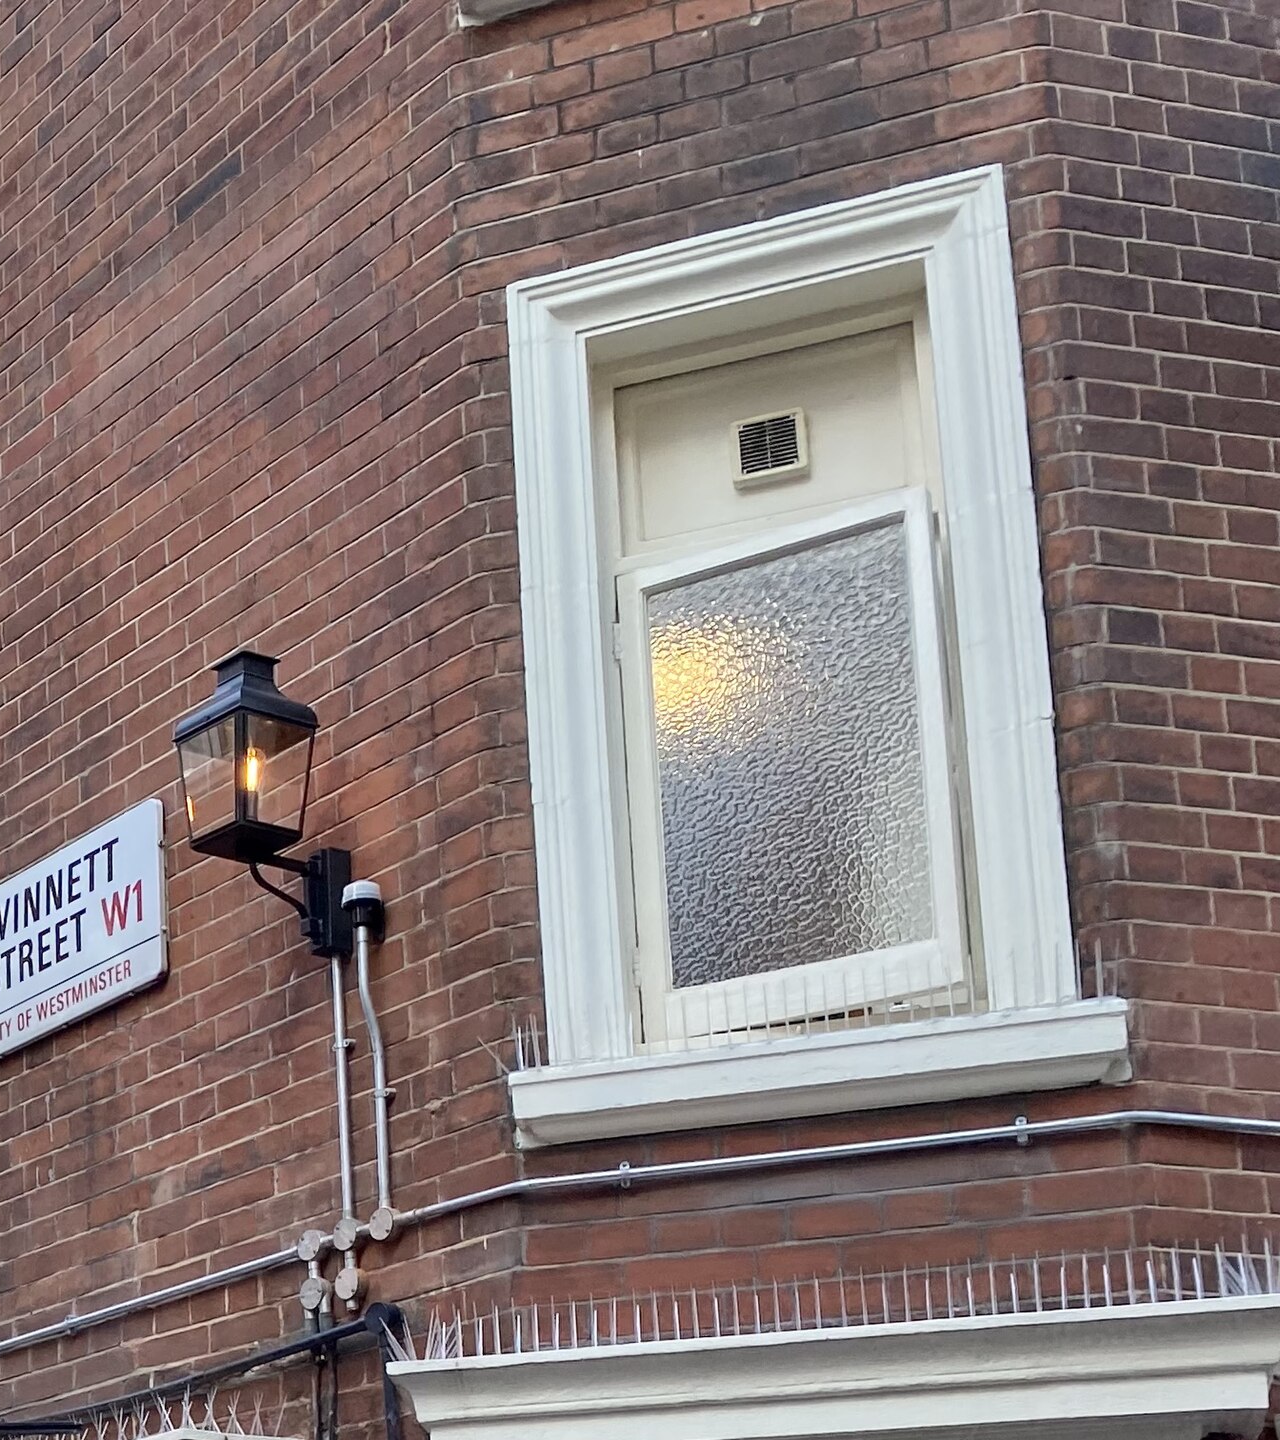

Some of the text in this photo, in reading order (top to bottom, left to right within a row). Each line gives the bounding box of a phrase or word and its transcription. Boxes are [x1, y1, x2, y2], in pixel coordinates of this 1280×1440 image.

[101, 879, 143, 937] W1
[17, 1008, 32, 1031] OF
[36, 959, 132, 1022] WESTMINSTER
